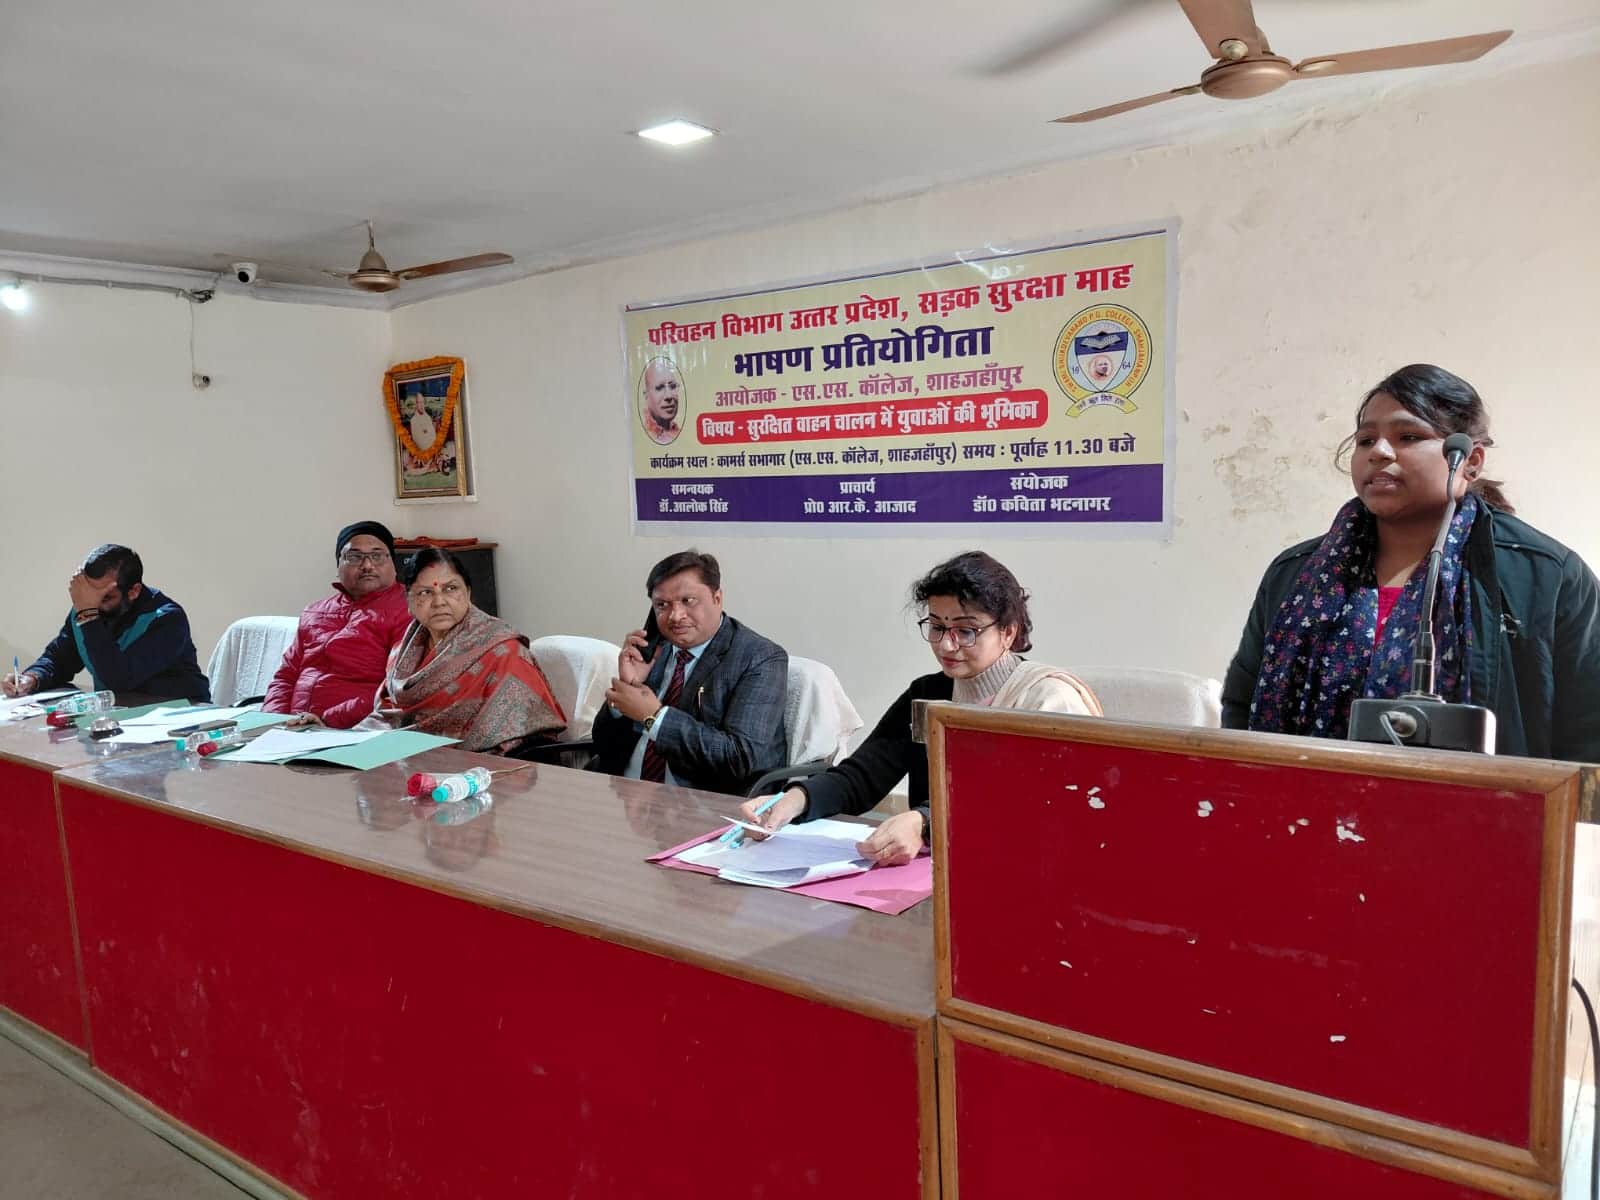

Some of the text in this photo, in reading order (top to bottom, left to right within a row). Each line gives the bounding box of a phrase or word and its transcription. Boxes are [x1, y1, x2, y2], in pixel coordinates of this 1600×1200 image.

[648, 264, 1134, 345] परिवहन विभाग उत्तर प्रदेश, सड़क सुरक्षा माह
[734, 325, 994, 377] भाषण प्रतियोगिता
[715, 385, 777, 407] आयोजक
[792, 382, 853, 401] एस.एस.
[858, 372, 920, 396] कॉलेज,
[702, 418, 735, 438] विषय
[747, 414, 793, 441] सुरक्षित
[795, 415, 831, 433] वाहन
[834, 412, 877, 431] चालन
[880, 405, 895, 428] में
[897, 401, 952, 433] युवाओं
[953, 400, 976, 423] की
[980, 398, 1039, 428] भूमिका
[650, 453, 684, 469] कार्यक्रम
[687, 456, 708, 468] स्थल
[717, 451, 745, 468] कामर्स
[749, 453, 786, 467] सभागार
[842, 446, 883, 466] कॉलेज,
[962, 444, 996, 459] समय
[1054, 438, 1103, 456] 11.30
[1109, 433, 1136, 453] बजे
[671, 484, 714, 495] समन्वयक
[840, 477, 876, 494] प्राचार्य
[1010, 472, 1069, 490] संयोजक
[709, 498, 729, 513] सिंह
[874, 500, 918, 513] आजाद
[1000, 495, 1046, 512] कविता
[1050, 497, 1111, 511] भटनागर
